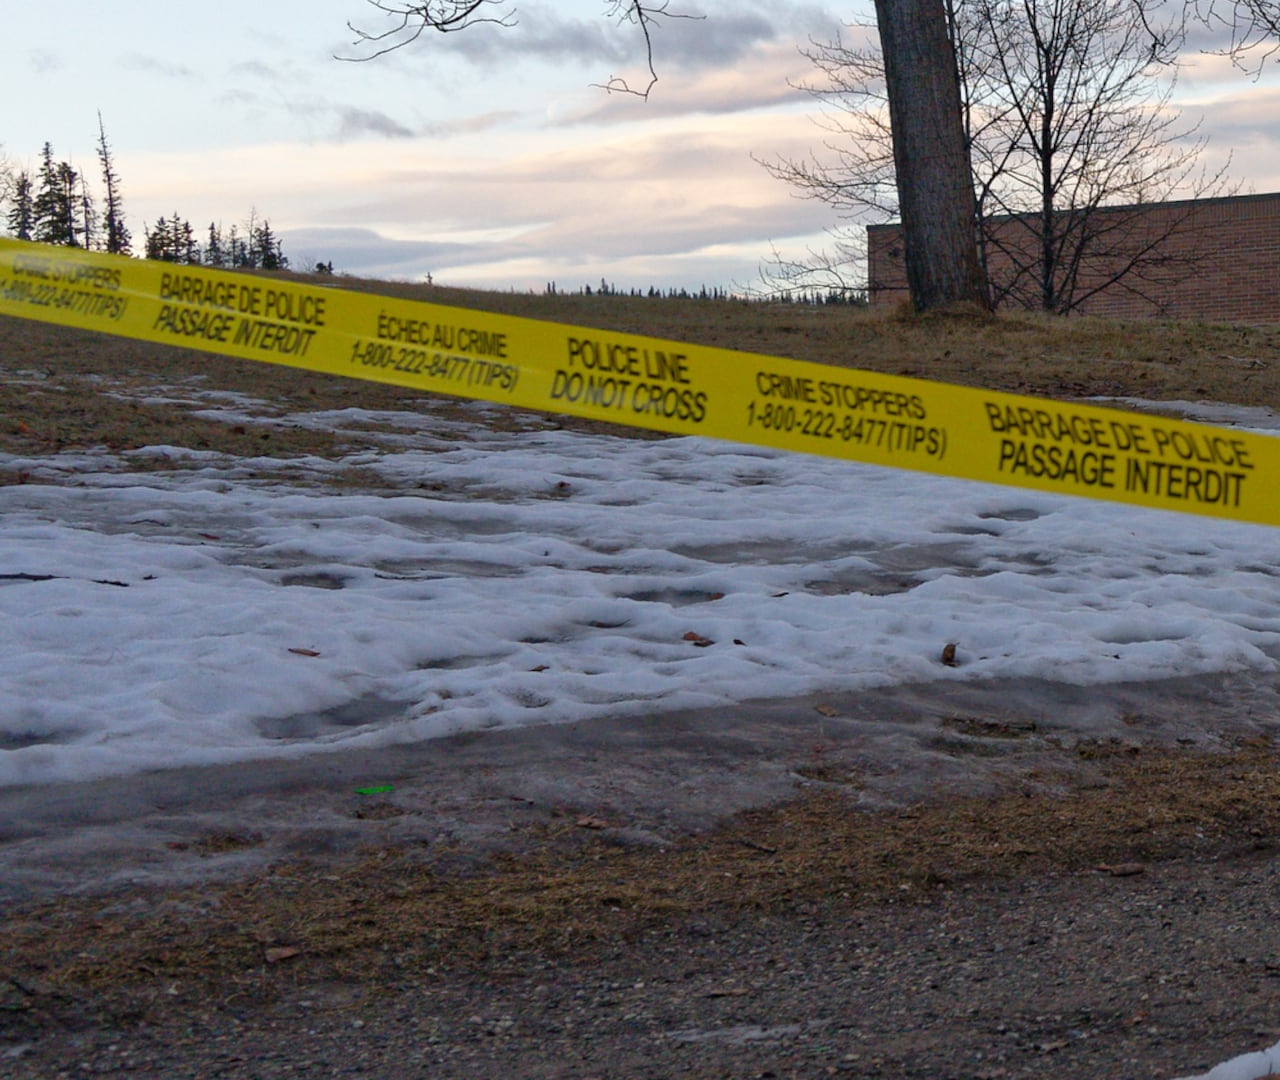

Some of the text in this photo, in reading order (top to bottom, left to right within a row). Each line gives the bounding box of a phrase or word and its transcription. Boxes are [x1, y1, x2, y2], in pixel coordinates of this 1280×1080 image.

[160, 273, 326, 326] BARRAGE DE POLICE
[153, 305, 317, 356] PASSAGE INTERDIT
[377, 309, 508, 358] ÉCHEC AU CRIME
[567, 337, 692, 385] POLICE LINE
[551, 370, 709, 423] DO NOT CROSS
[756, 371, 927, 420] CRIME STOPPERS
[984, 401, 1256, 470] BARRAGE DE POLICE
[998, 438, 1247, 508] PASSAGE INTERDIT
